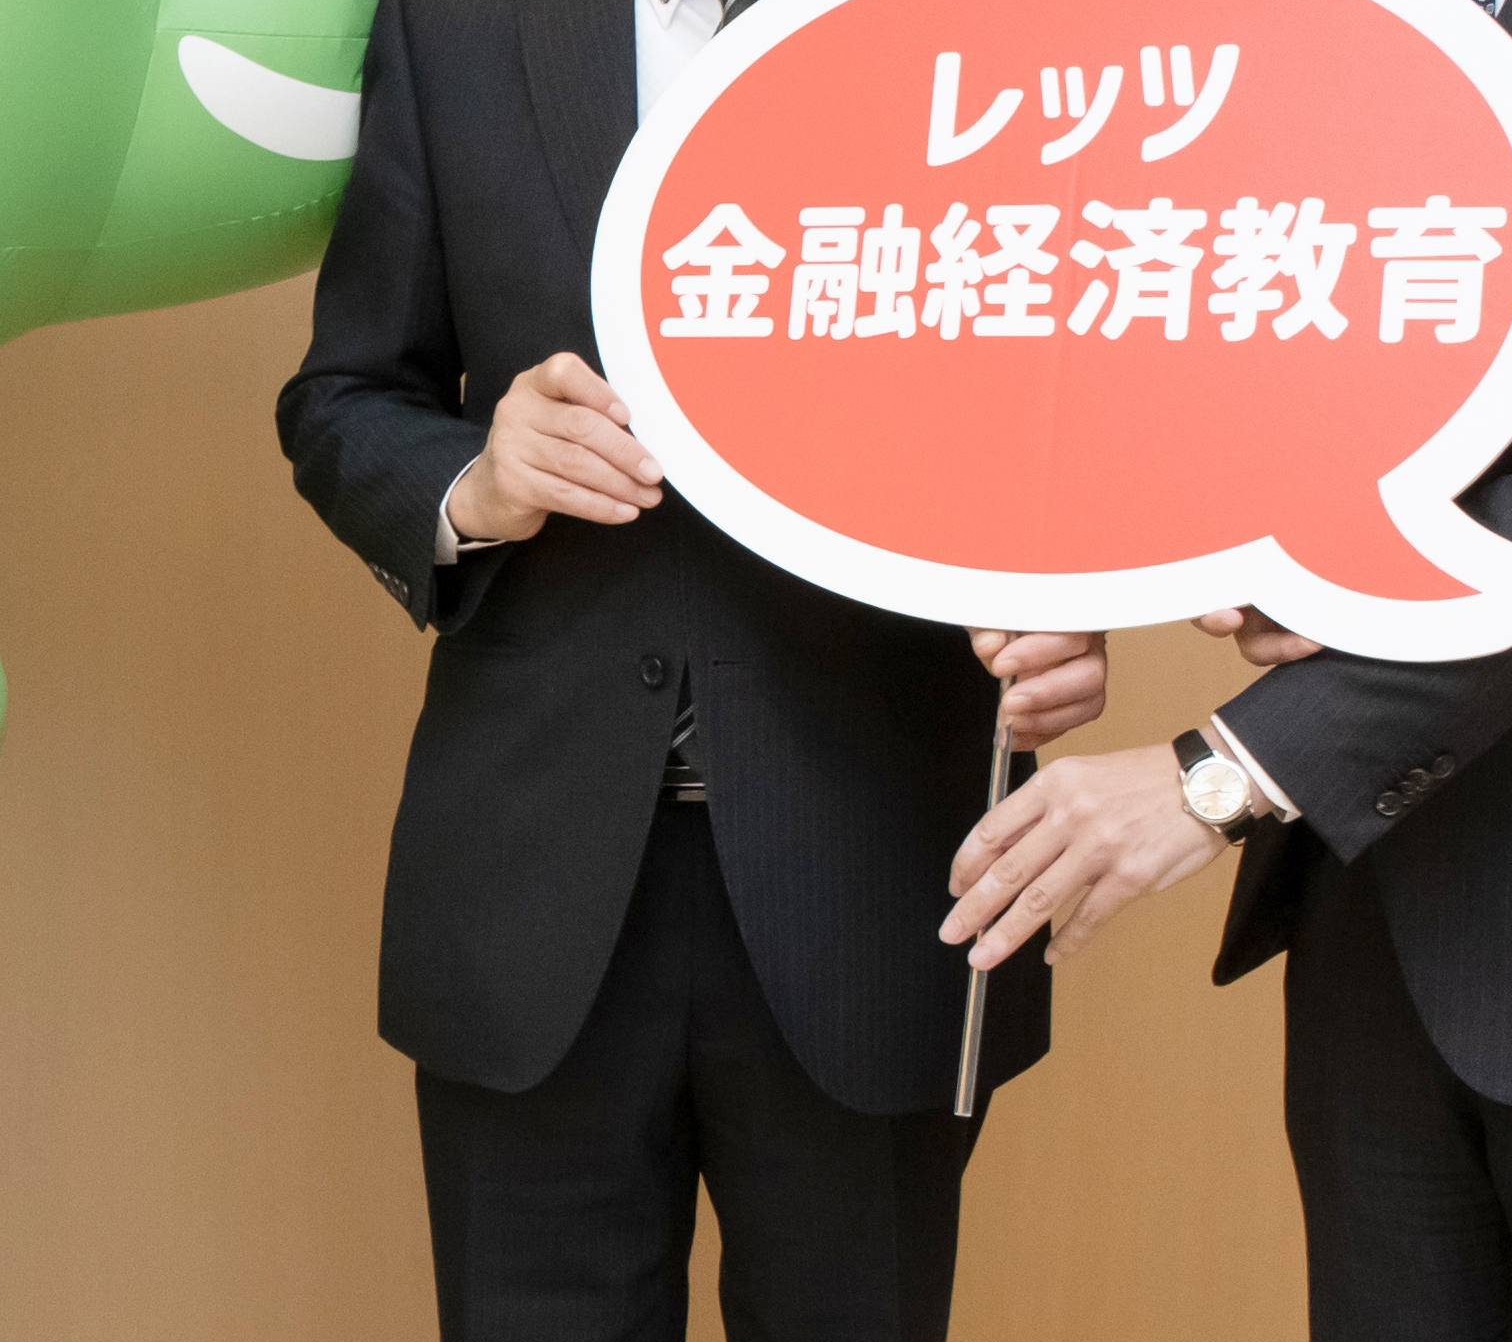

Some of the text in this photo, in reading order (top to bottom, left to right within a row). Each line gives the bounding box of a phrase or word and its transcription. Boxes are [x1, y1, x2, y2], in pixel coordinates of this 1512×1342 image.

[926, 43, 1241, 167] レッツ
[659, 194, 1508, 344] 金融経済教育
